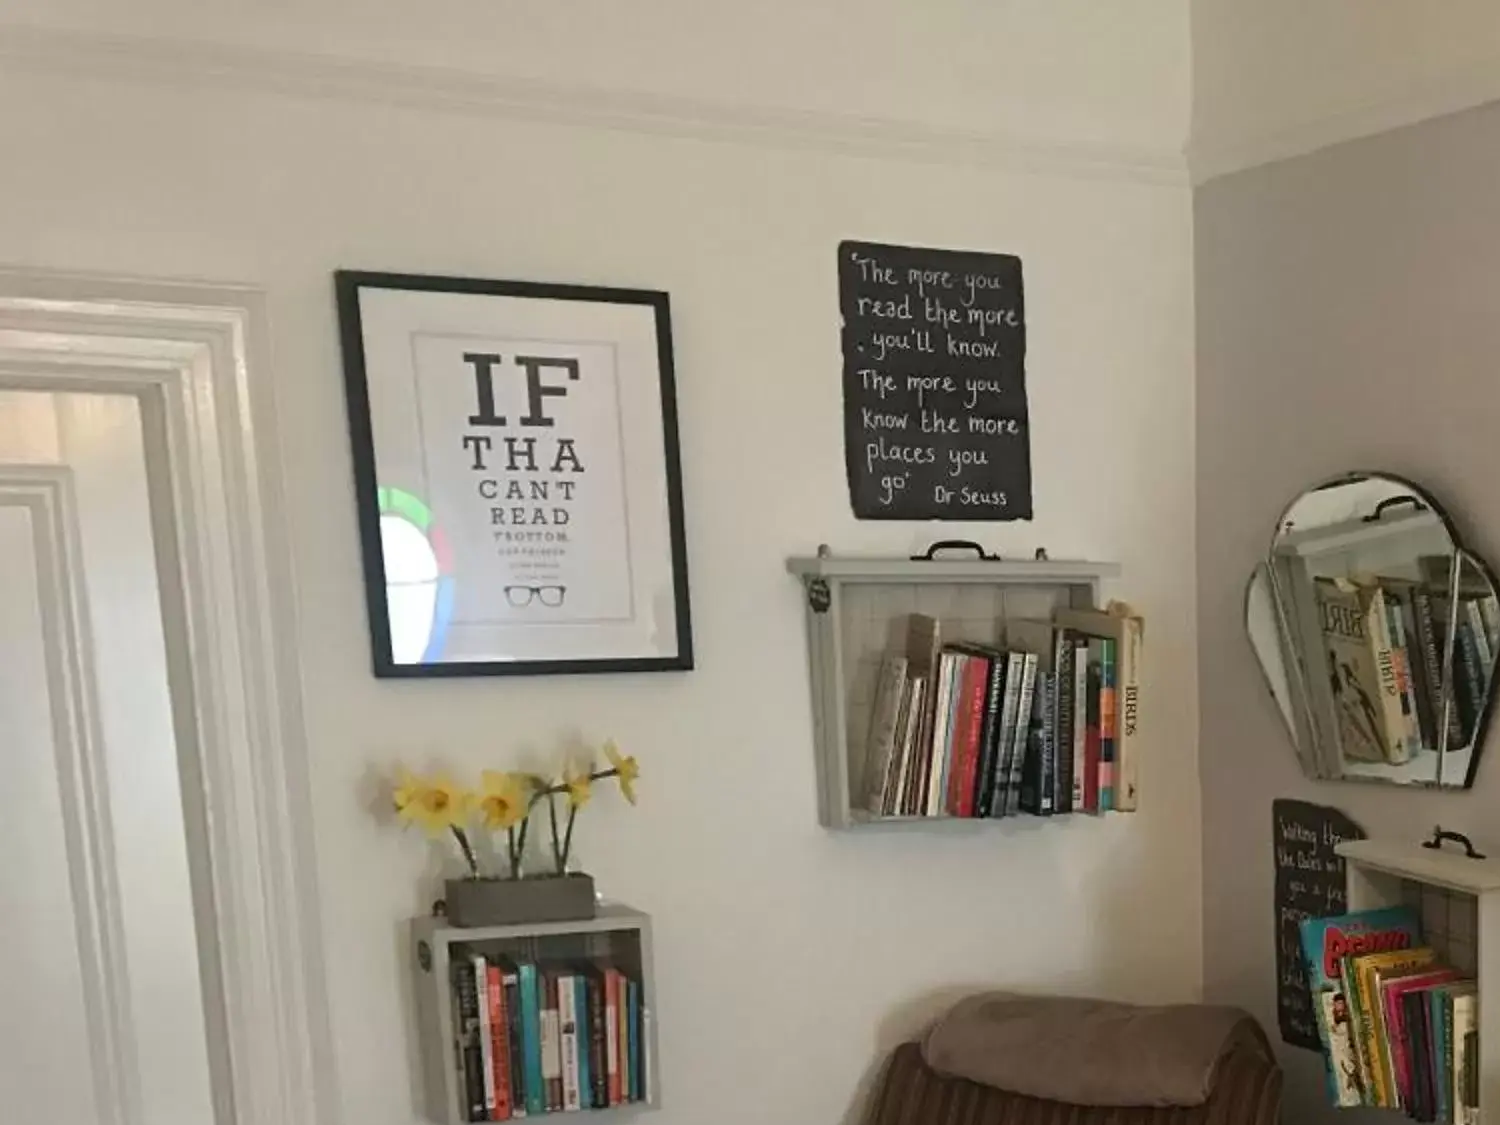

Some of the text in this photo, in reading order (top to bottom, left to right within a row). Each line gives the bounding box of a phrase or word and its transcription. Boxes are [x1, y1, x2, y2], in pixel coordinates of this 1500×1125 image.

[908, 268, 952, 298] more
[964, 270, 1001, 307] you
[857, 294, 1019, 336] read the more
[873, 327, 936, 361] you'll
[463, 352, 580, 427] IF
[857, 369, 1001, 409] The more you
[921, 409, 960, 433] the
[968, 415, 1019, 434] more
[462, 436, 585, 472] THA
[867, 437, 989, 477] places you
[935, 485, 1007, 507] Dr Seuss
[490, 507, 569, 525] READ
